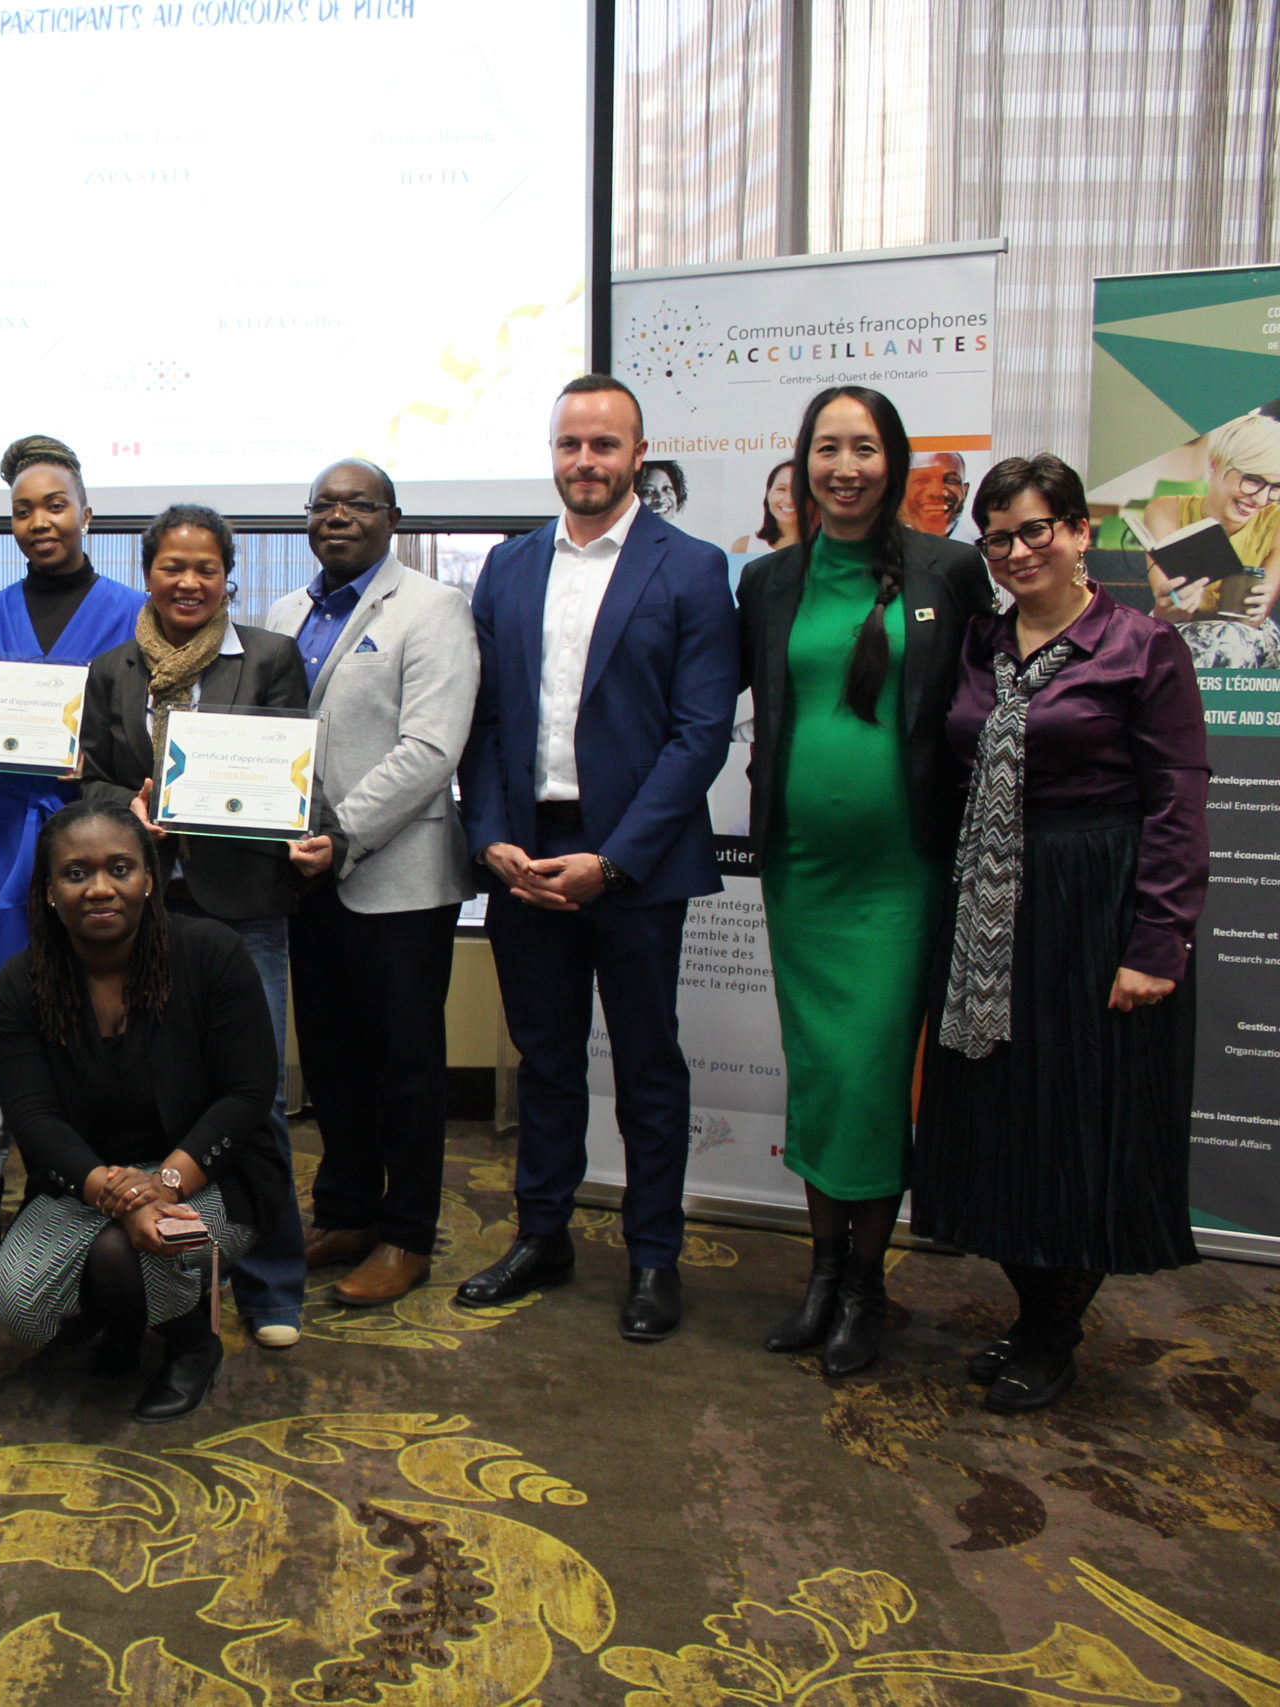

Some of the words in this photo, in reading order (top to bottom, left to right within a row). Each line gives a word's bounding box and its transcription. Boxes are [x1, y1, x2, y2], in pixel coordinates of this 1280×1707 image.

[0, 4, 143, 36] PARTICIPANTS
[152, 2, 183, 29] AU
[192, 0, 309, 27] CONCOURS
[318, 0, 343, 23] DE
[353, 0, 415, 20] PITCH
[726, 317, 854, 342] Communautés
[859, 311, 988, 333] francophones
[725, 334, 988, 365] ACCUEILLANTES
[779, 371, 867, 385] Centre-Sud-Ouest
[869, 370, 883, 381] de
[884, 368, 928, 381] l'Ontario
[651, 434, 730, 453] initiative
[735, 433, 764, 455] qui
[8, 697, 62, 708] d'appréciation
[1238, 711, 1265, 726] AND
[192, 751, 228, 762] Certificat
[230, 754, 289, 766] d'appréciation
[1208, 875, 1258, 886] ommunity
[732, 931, 740, 943] à
[744, 932, 756, 944] la
[1212, 927, 1265, 940] Recherche
[1267, 931, 1279, 940] et
[732, 947, 754, 960] des
[1217, 952, 1263, 964] Research
[678, 976, 706, 988] avec
[710, 977, 721, 989] la
[725, 980, 767, 994] région
[1237, 1021, 1277, 1033] Gestion
[710, 1061, 745, 1073] pour
[749, 1063, 782, 1077] tous
[1239, 1139, 1272, 1151] Affairs
